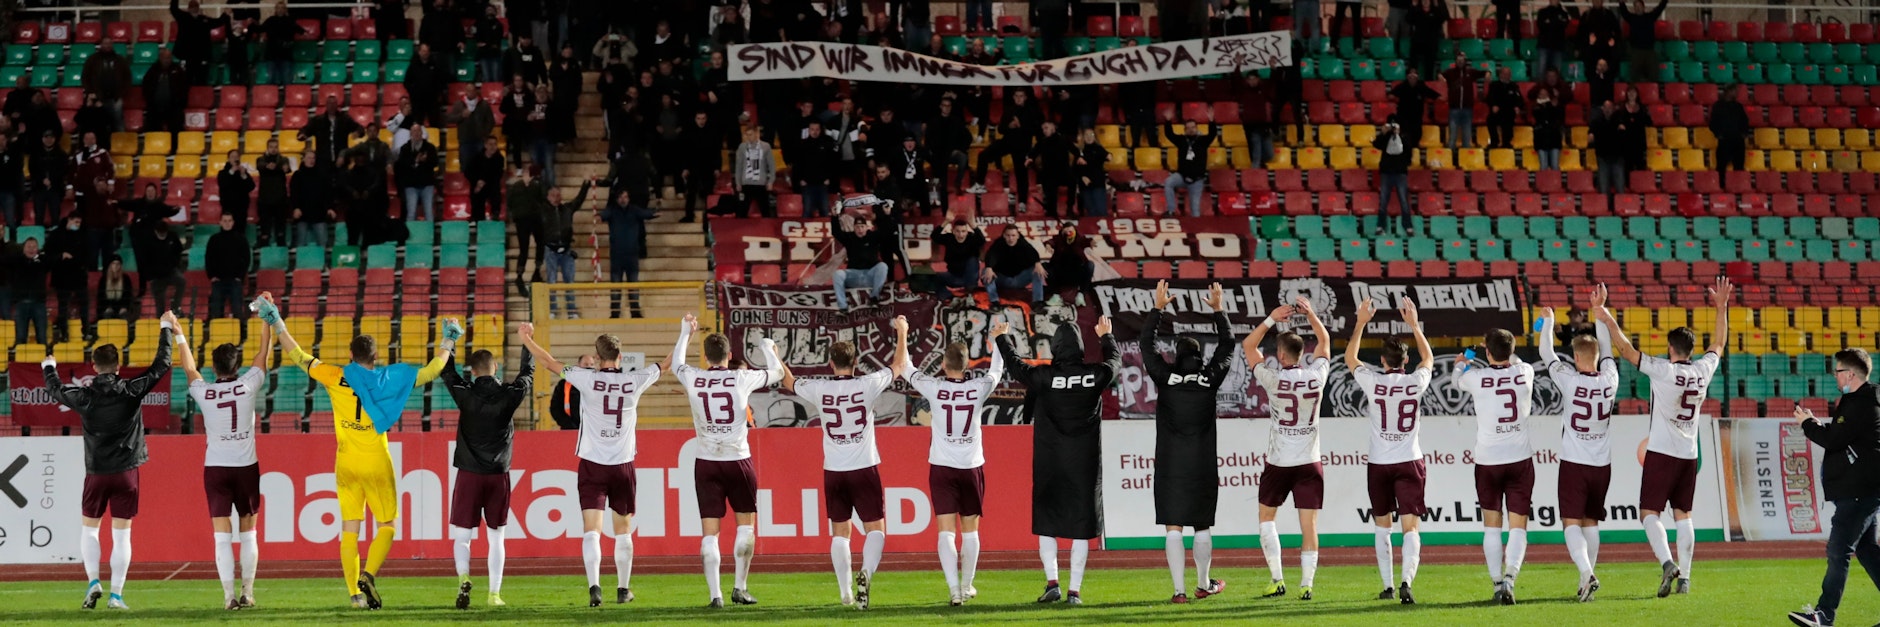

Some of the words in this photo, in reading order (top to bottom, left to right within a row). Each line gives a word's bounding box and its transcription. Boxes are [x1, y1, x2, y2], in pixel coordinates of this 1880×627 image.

[737, 44, 816, 74] SIND
[820, 44, 874, 75] WIR
[1096, 218, 1183, 234] 1966
[1414, 278, 1518, 312] BERLIN
[730, 309, 774, 326] OHNE
[776, 309, 811, 326] UNS
[593, 380, 634, 394] BFC
[694, 377, 736, 389] BFC
[1051, 374, 1097, 390] BFC
[1167, 372, 1211, 388] BFC
[1277, 379, 1320, 391] BFC
[1481, 374, 1527, 388] BFC
[1674, 375, 1706, 388] BFC
[205, 384, 246, 400] BFC
[822, 391, 865, 406] BFC
[937, 389, 978, 401] BFC
[1374, 384, 1418, 397] BFC
[1574, 386, 1613, 399] BFC
[603, 394, 624, 429] 4
[697, 391, 735, 424] 13
[1276, 391, 1321, 427] 37
[1495, 388, 1518, 423] 3
[1676, 390, 1699, 421] 5
[216, 400, 238, 433] 7
[822, 405, 868, 440] 23
[941, 404, 975, 437] 17
[1374, 398, 1418, 433] 18
[1570, 399, 1613, 433] 24
[601, 429, 621, 438] BLUM
[1495, 423, 1521, 434] BLUME
[40, 453, 55, 509] GmbH
[1756, 441, 1776, 518] PILSENER
